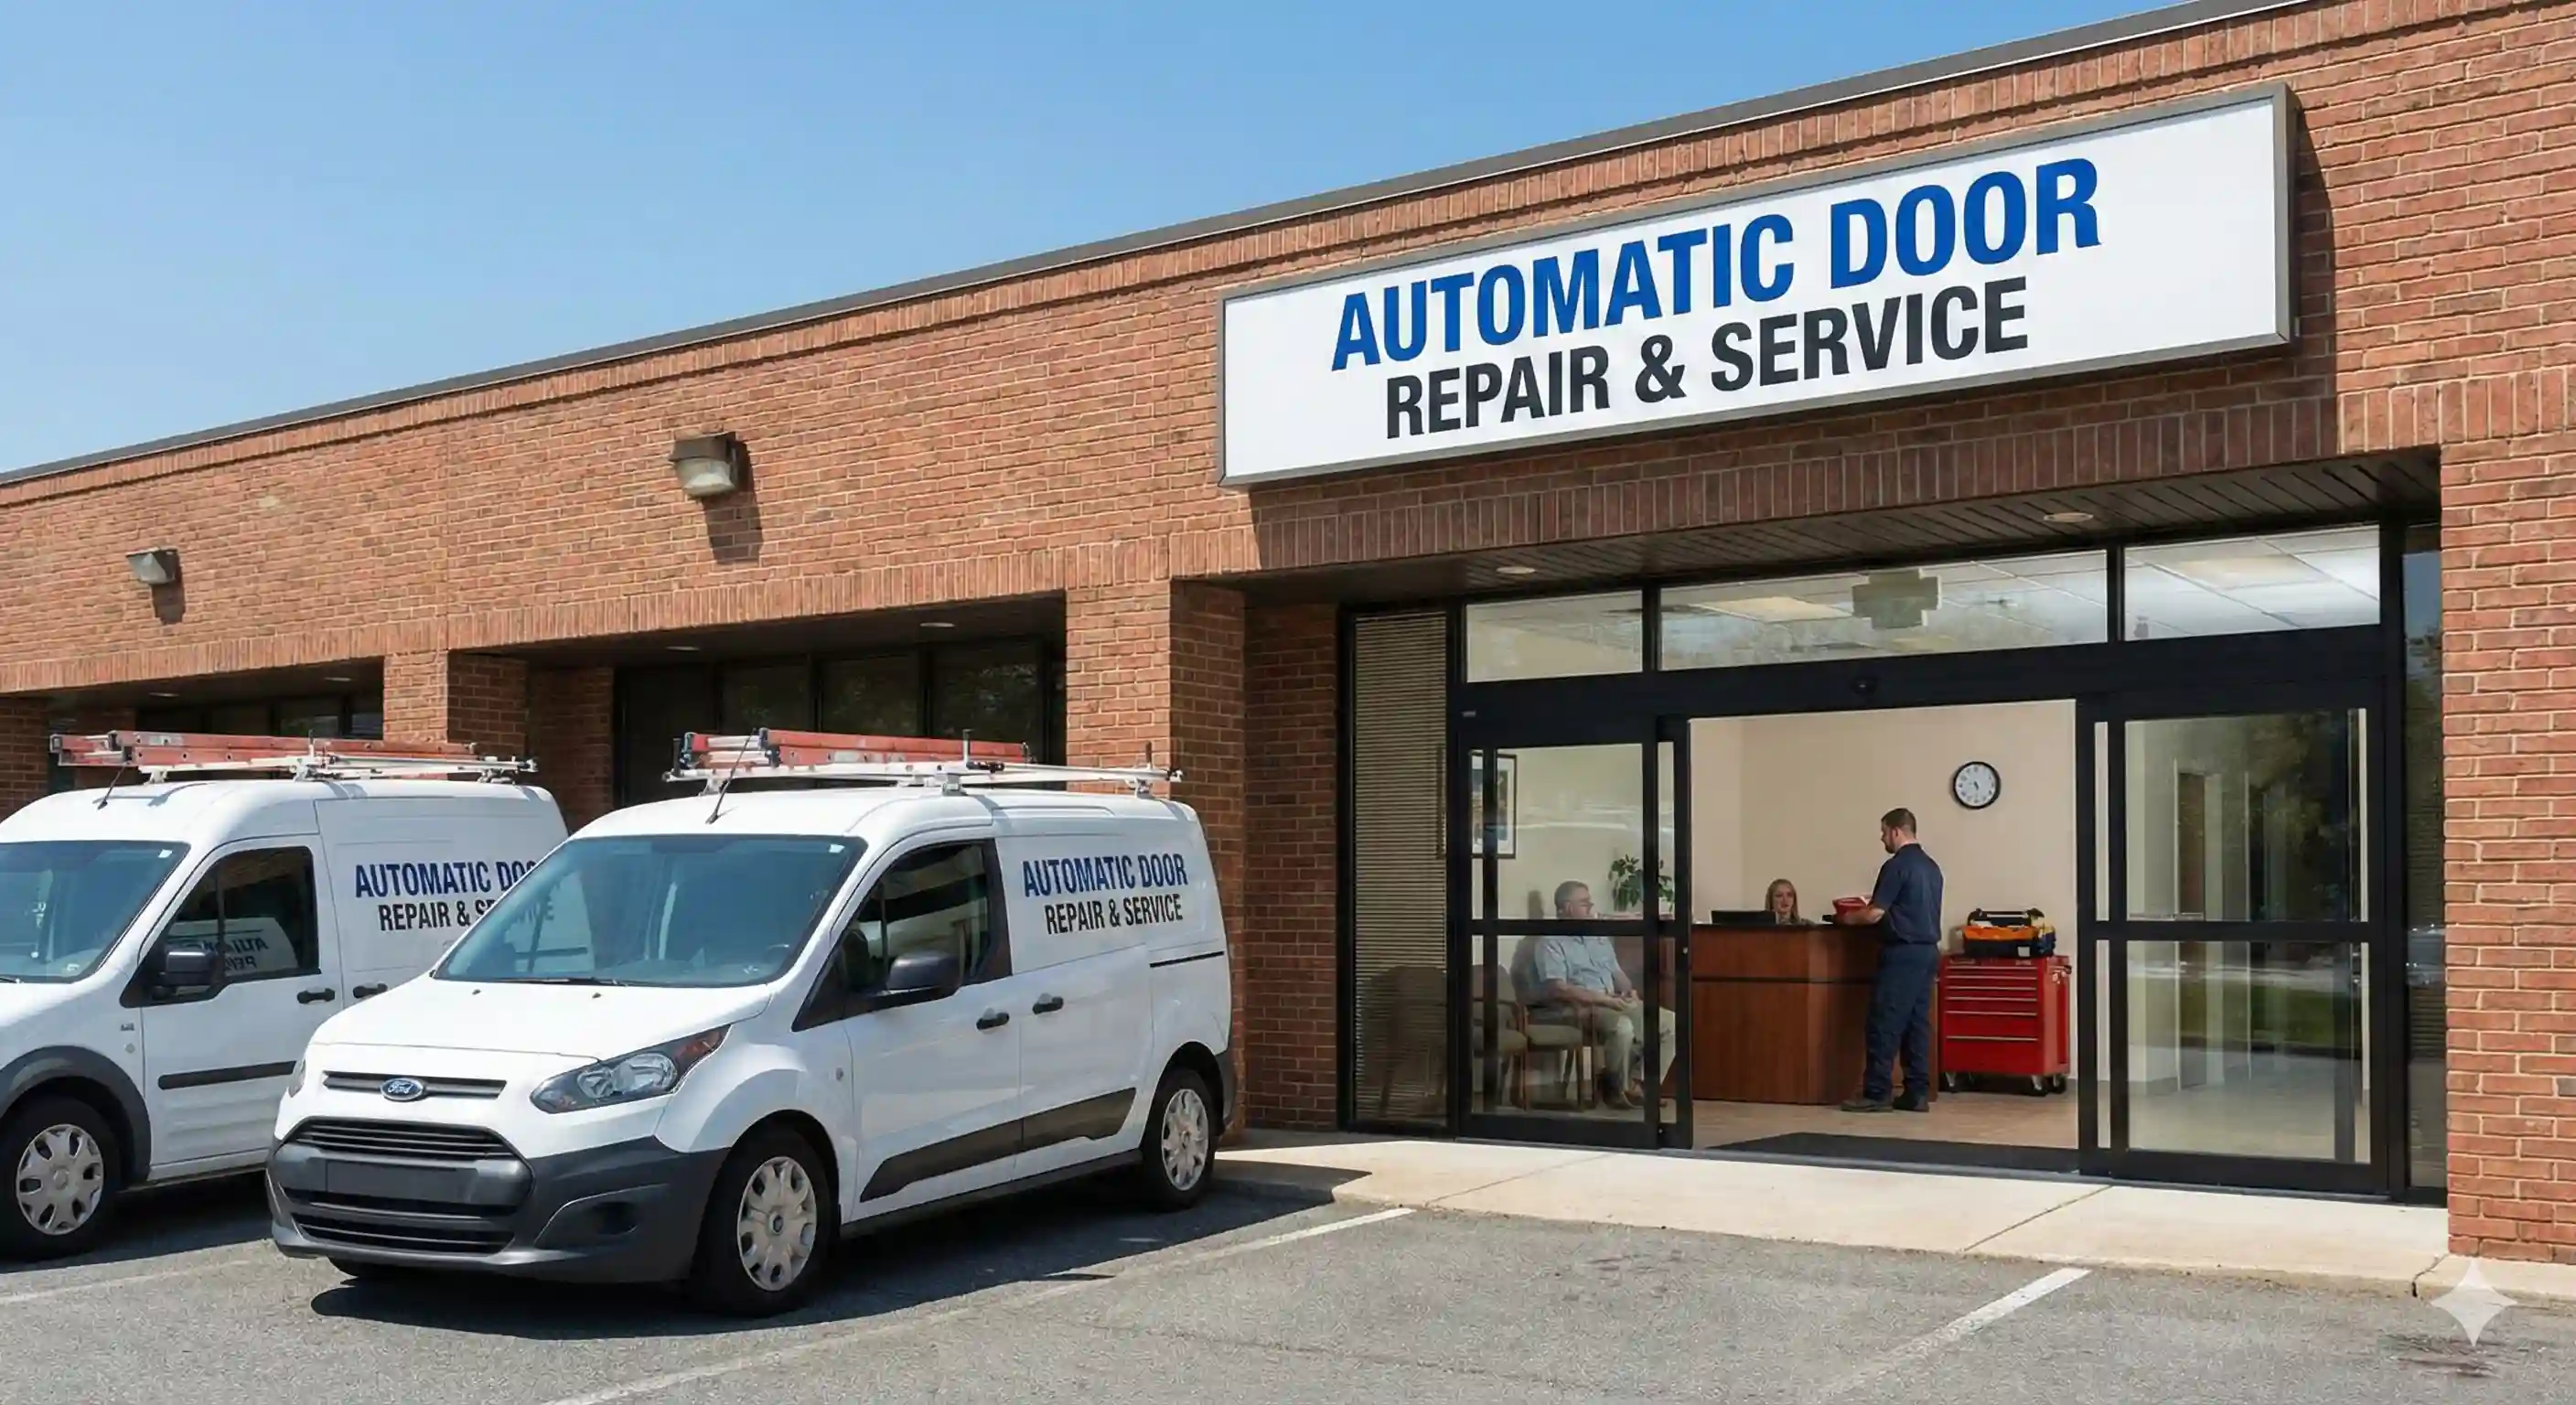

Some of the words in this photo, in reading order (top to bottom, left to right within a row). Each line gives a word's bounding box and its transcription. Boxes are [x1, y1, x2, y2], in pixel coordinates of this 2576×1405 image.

[1331, 214, 1796, 371] AUTOMATIC
[1830, 157, 2101, 290] DOOR
[1385, 345, 1611, 440] REPAIR
[1635, 334, 1687, 403] &
[1711, 275, 2028, 392] SERVICE
[355, 861, 492, 898] AUTOMATIC
[1022, 854, 1136, 898] AUTOMATIC
[1137, 853, 1189, 888] DOOR
[378, 901, 451, 931] REPAIR
[456, 900, 472, 927] &
[1044, 900, 1106, 935] REPAIR
[1108, 898, 1122, 928] &
[1122, 893, 1184, 927] SERVICE
